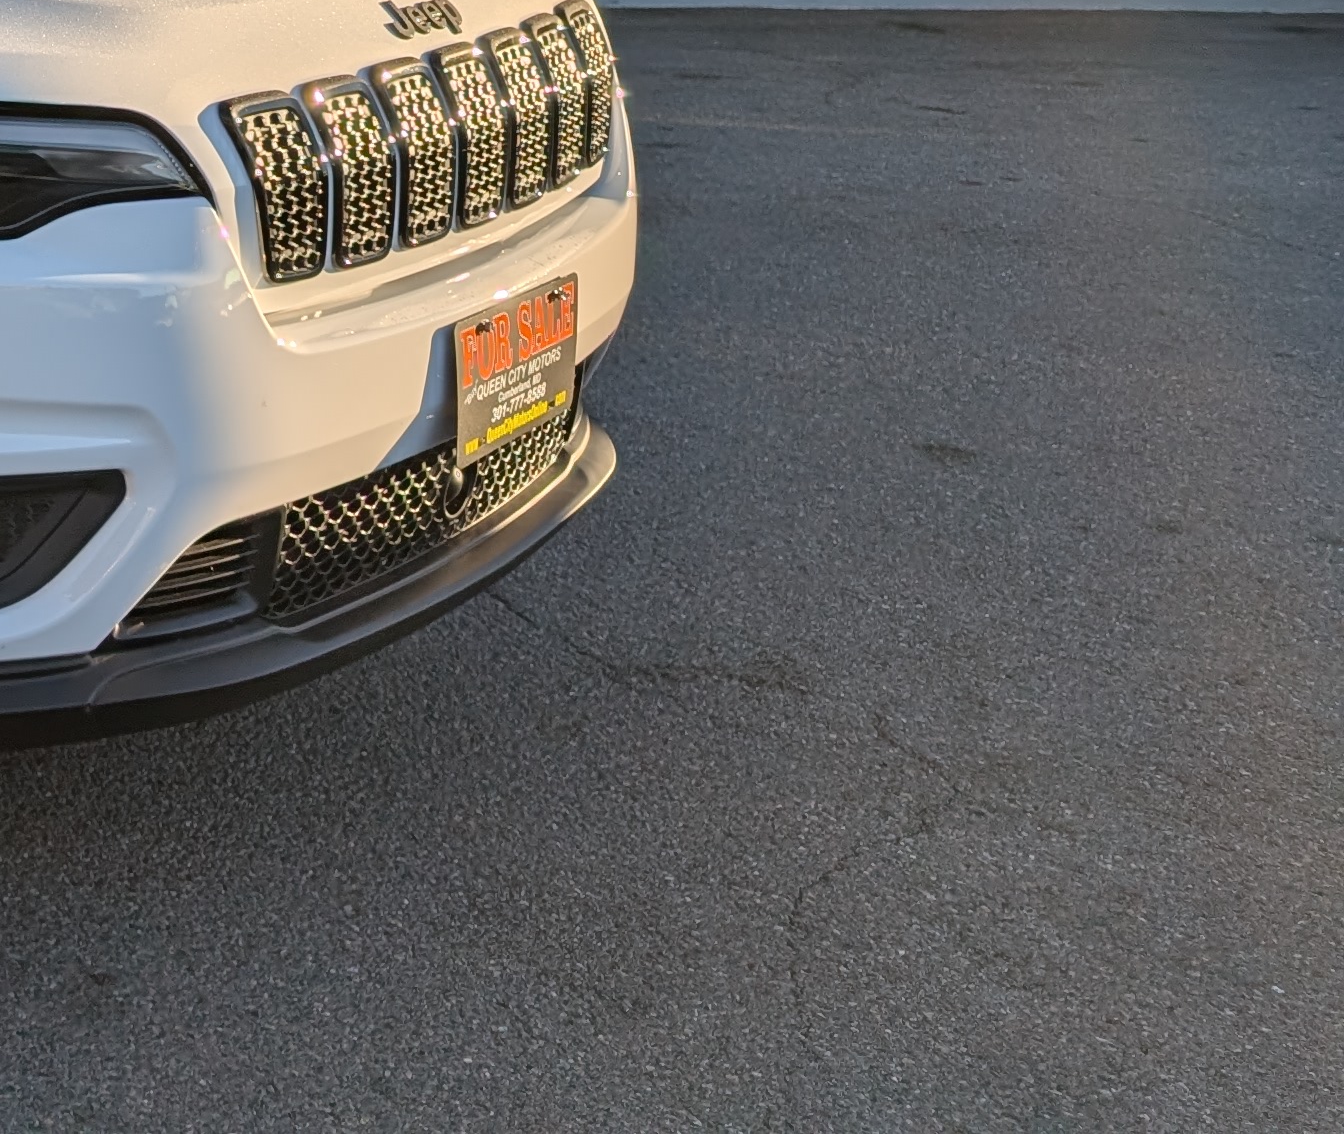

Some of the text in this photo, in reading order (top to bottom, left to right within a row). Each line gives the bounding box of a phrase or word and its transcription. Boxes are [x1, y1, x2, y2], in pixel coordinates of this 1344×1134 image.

[460, 281, 575, 390] FOR SALE
[476, 374, 507, 401] QUEEN
[508, 364, 527, 389] CITY
[527, 346, 562, 377] MOTORS
